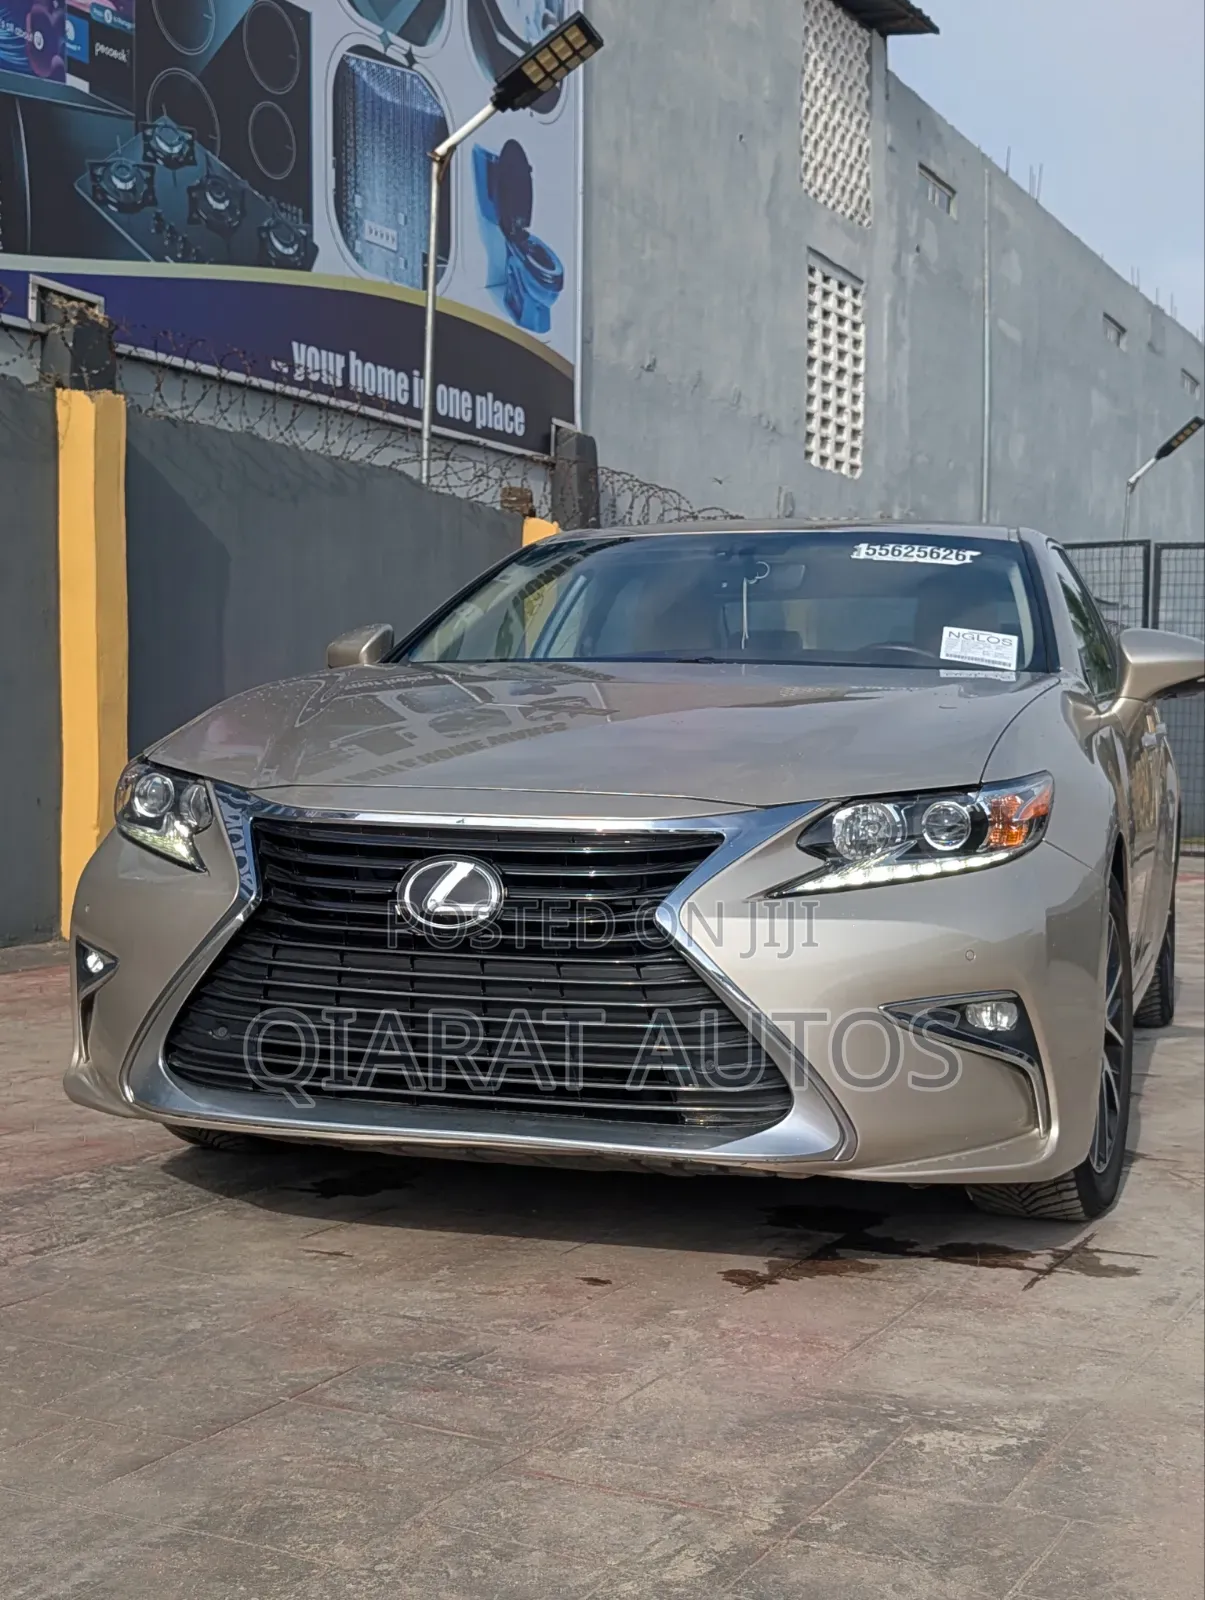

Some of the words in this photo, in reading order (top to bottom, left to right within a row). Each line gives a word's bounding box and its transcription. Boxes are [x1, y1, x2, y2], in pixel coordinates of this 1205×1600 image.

[349, 349, 409, 405] home
[435, 383, 473, 422] one
[475, 391, 525, 436] place
